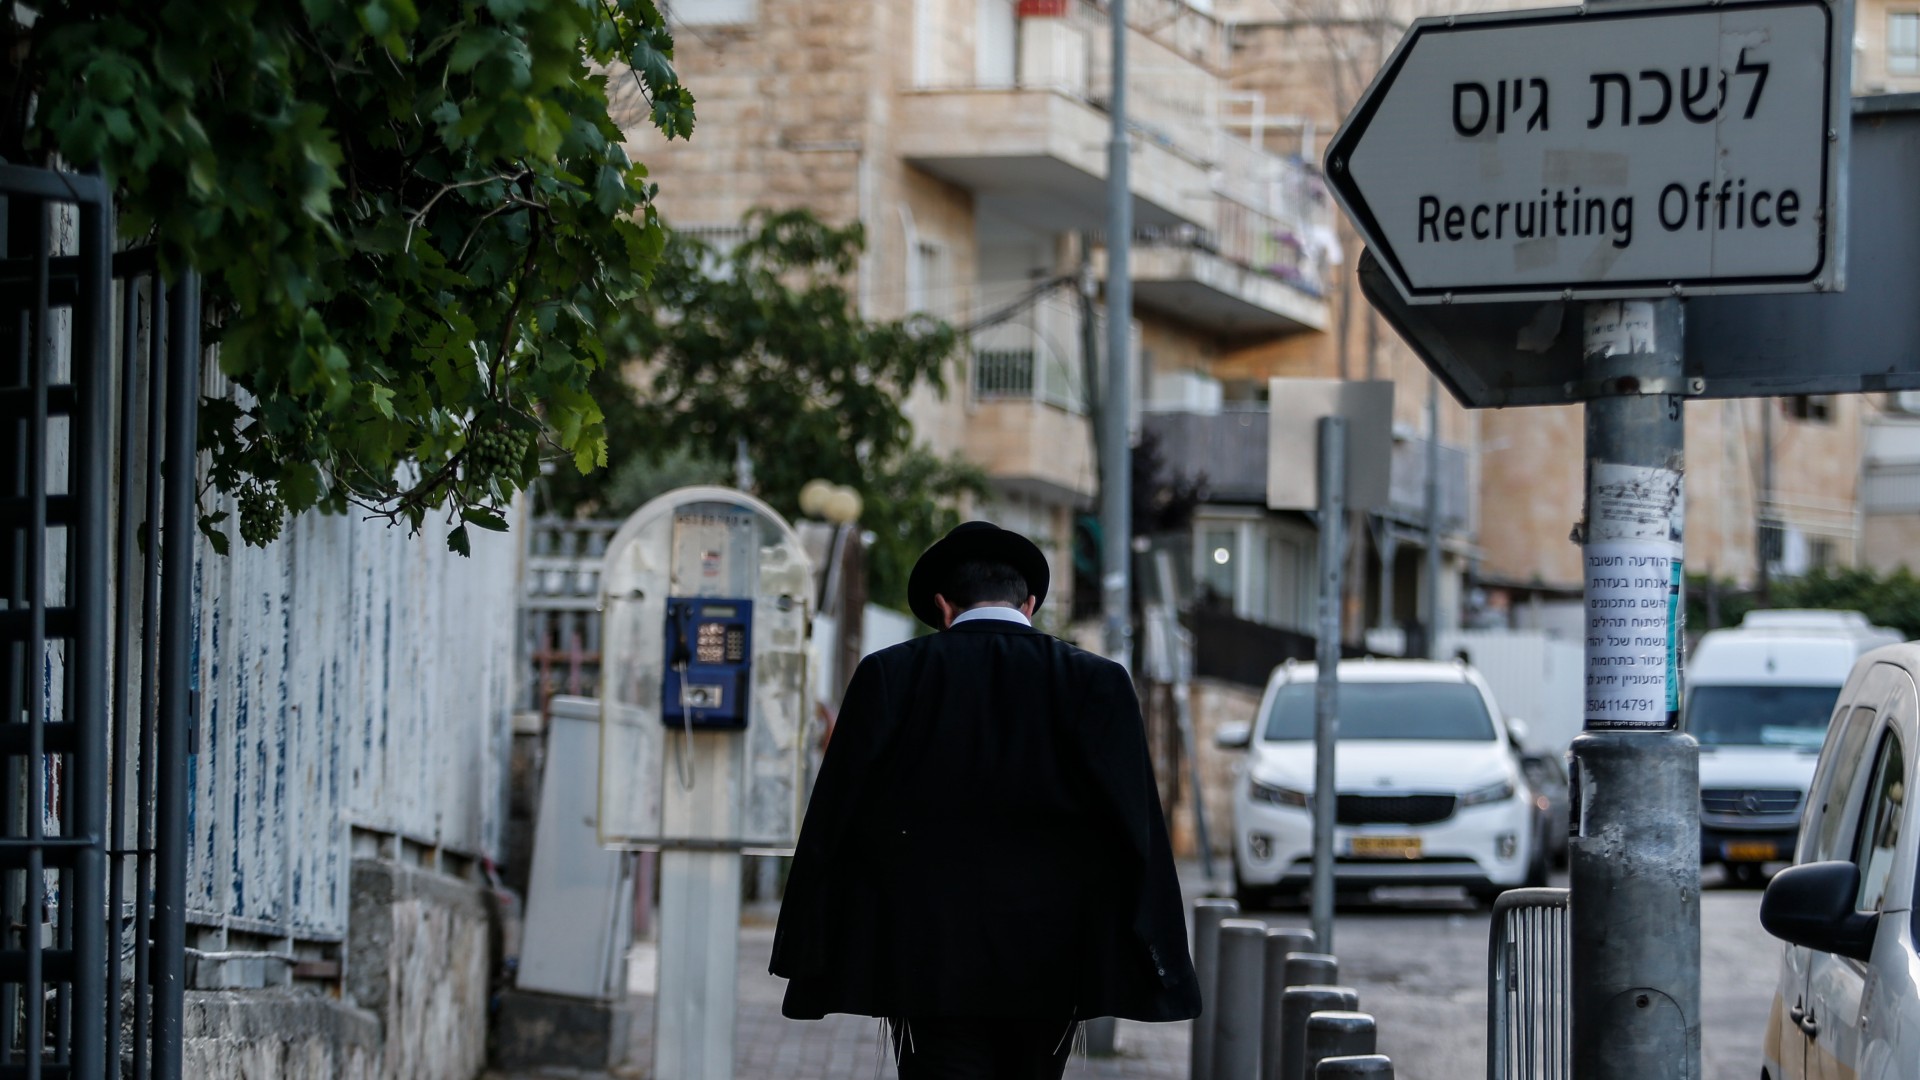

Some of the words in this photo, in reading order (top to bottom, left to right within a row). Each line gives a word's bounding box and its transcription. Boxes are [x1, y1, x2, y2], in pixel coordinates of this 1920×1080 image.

[1586, 47, 1769, 129] לשכת
[1452, 78, 1549, 137] גיוס
[1417, 186, 1634, 249] Recruiting
[1658, 179, 1799, 232] Office
[1588, 556, 1623, 567] חשובה
[1628, 556, 1669, 567] הודעה
[1592, 577, 1629, 588] בעזרת
[1634, 578, 1668, 588] אנחנו
[1591, 599, 1636, 609] מתכוננים
[1641, 599, 1666, 609] השם
[1592, 615, 1626, 628] תהילים
[1631, 616, 1666, 628] לפתוח
[1607, 635, 1630, 646] שכל
[1635, 637, 1665, 647] נשמח
[1591, 656, 1635, 666] בתרומות
[1639, 656, 1665, 666] יעזור
[1596, 675, 1618, 685] יחייג
[1622, 675, 1665, 687] המעוניין
